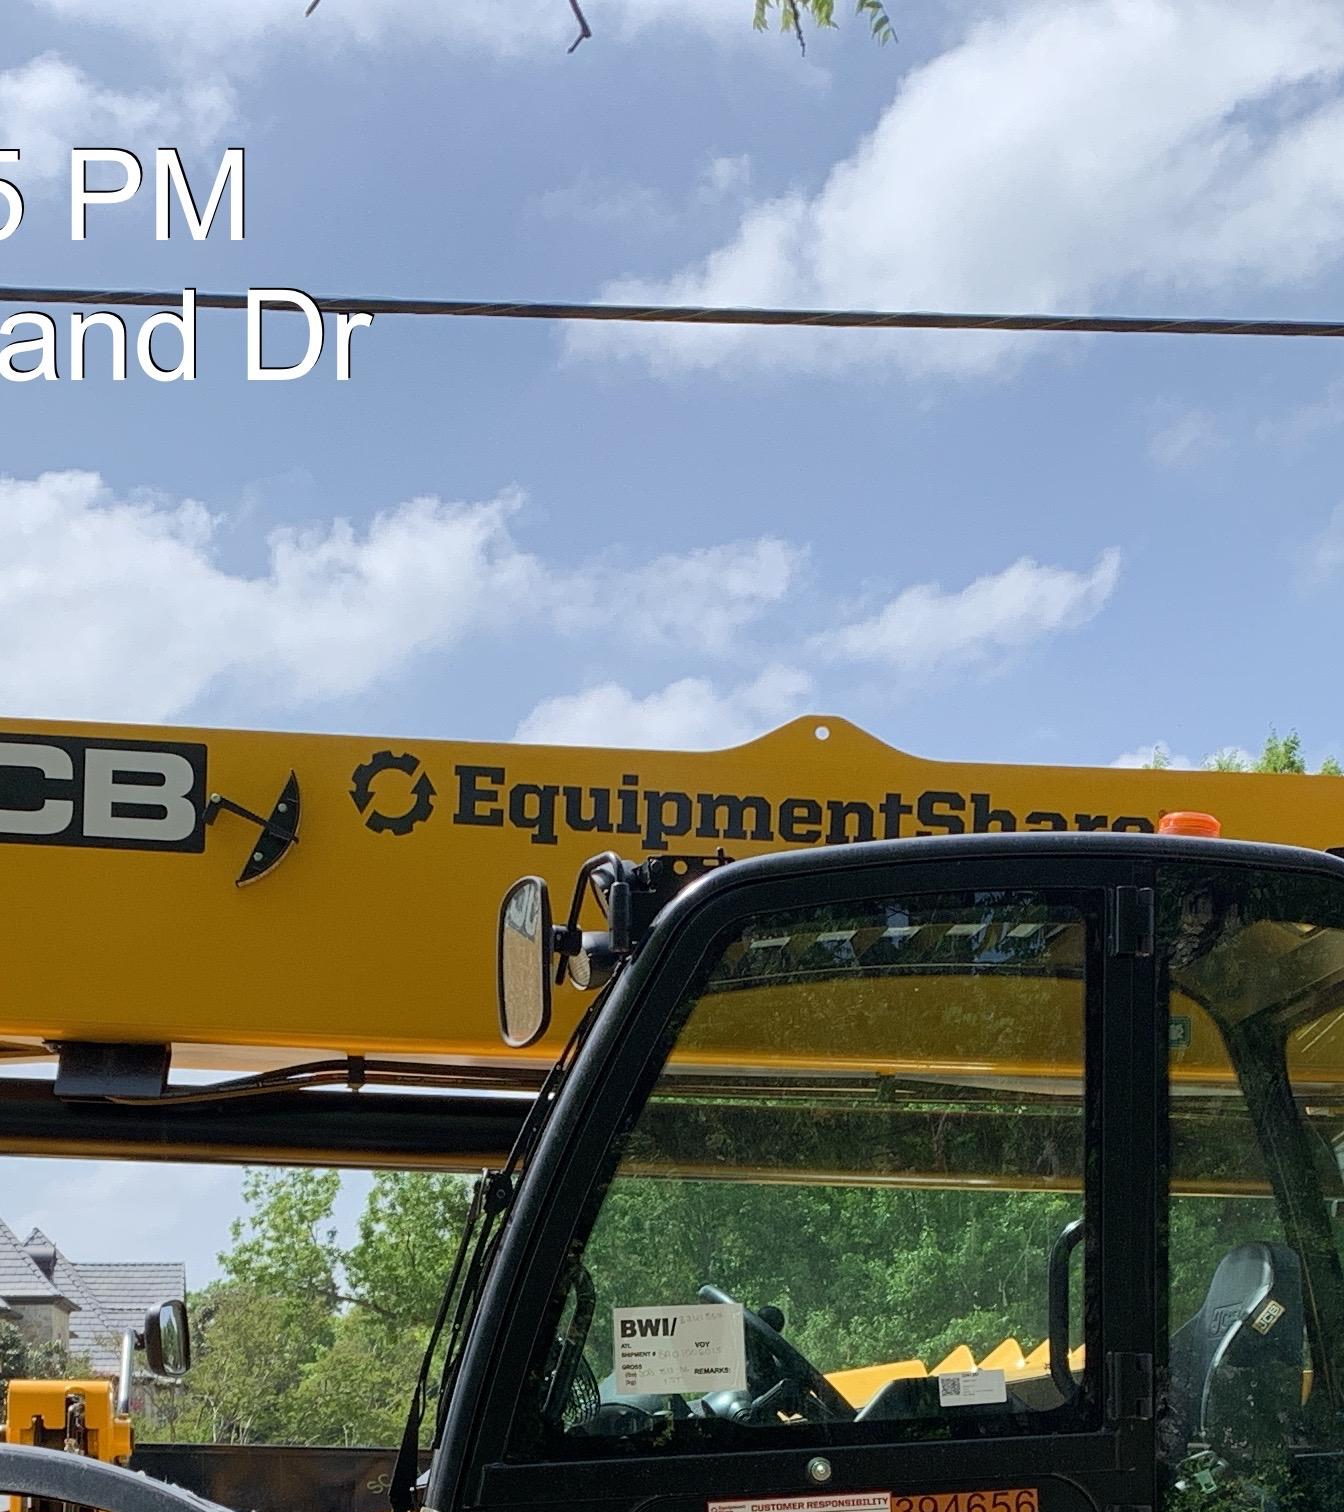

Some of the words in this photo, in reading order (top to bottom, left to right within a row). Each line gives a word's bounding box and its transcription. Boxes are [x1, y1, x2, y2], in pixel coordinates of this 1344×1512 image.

[694, 1340, 710, 1348] VOY
[751, 1501, 804, 1512] CUSTOMER
[806, 1496, 888, 1509] RESPONSIBILITY
